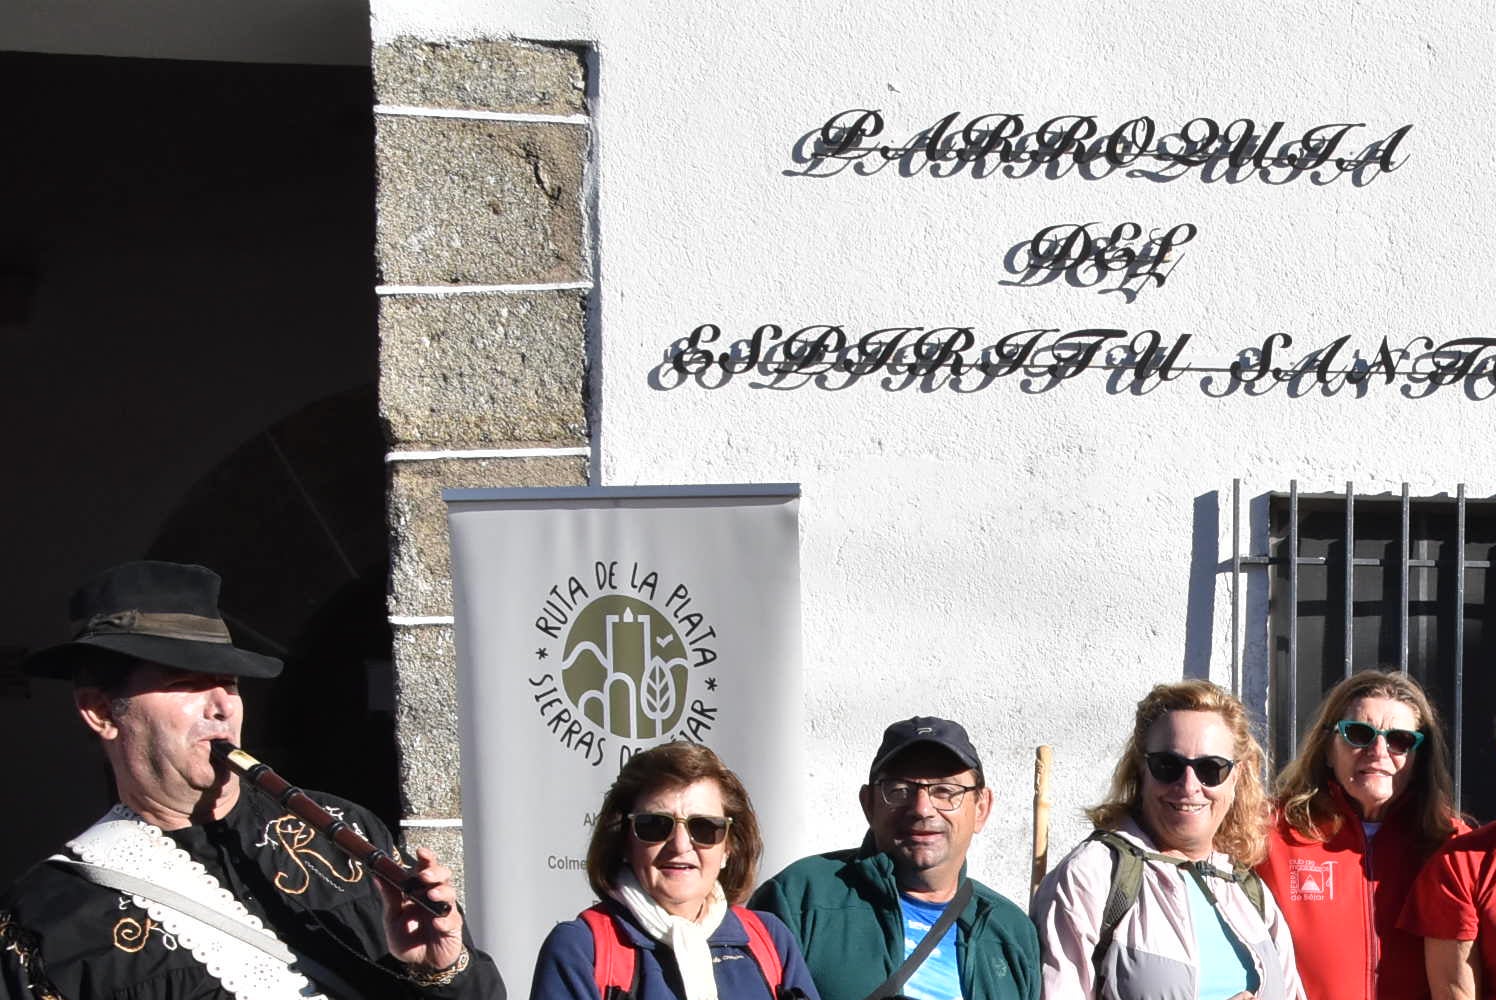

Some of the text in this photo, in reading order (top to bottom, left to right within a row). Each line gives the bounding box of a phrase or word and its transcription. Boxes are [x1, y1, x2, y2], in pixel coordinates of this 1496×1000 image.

[813, 109, 1413, 174] PARROQUIA
[1029, 222, 1197, 288] DEL
[674, 323, 1193, 381] ESPIRITU
[535, 561, 717, 667] RUTA DE LA PLATA
[528, 674, 606, 766] SIERRAS
[620, 745, 642, 770] D
[547, 855, 588, 870] Colme
